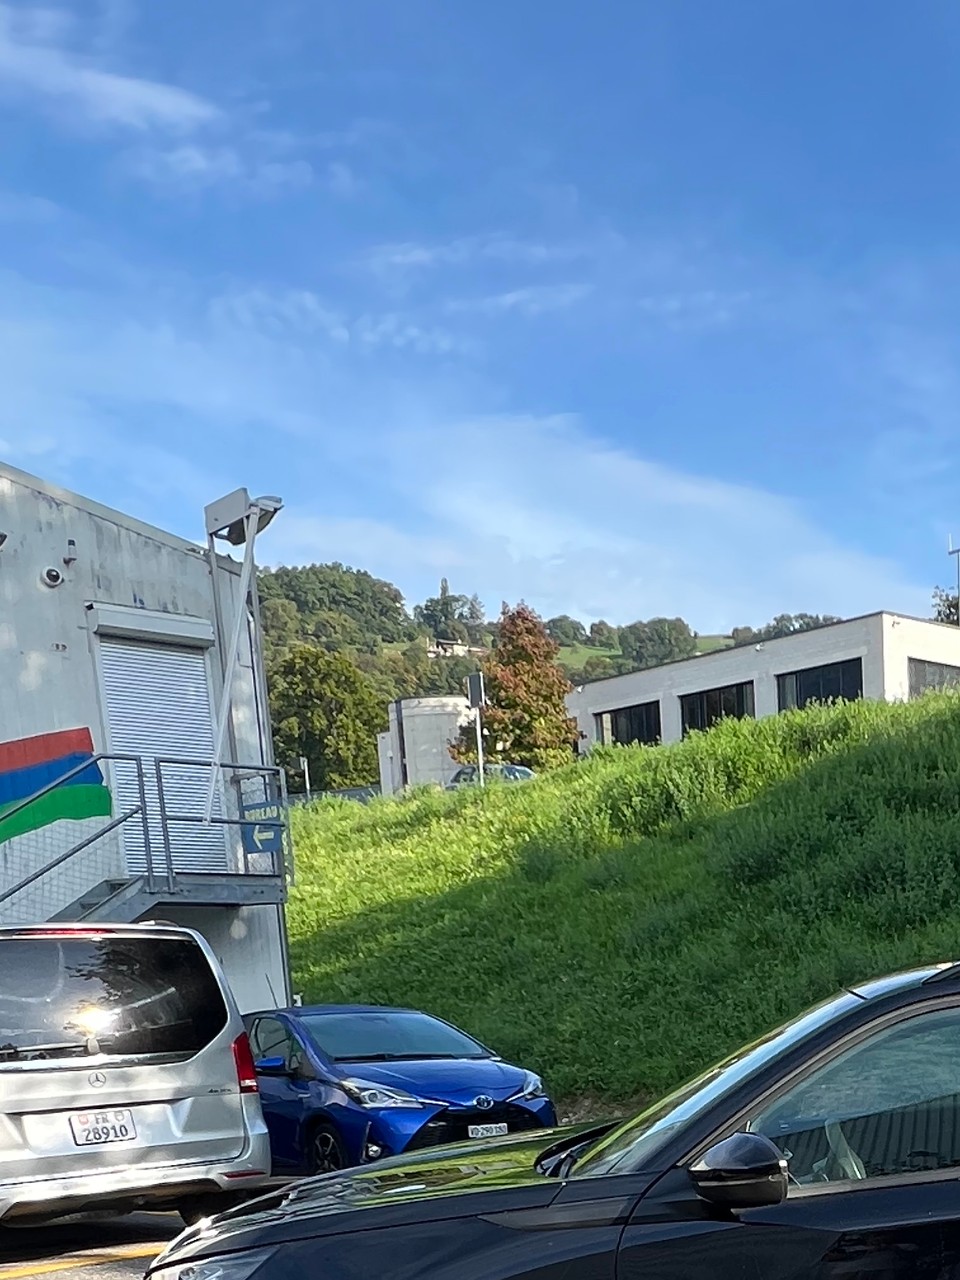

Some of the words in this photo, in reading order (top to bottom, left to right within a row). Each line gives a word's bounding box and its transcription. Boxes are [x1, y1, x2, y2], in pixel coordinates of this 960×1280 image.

[244, 805, 278, 821] BUREAU
[95, 1112, 109, 1125] FR
[82, 1124, 129, 1142] 28910
